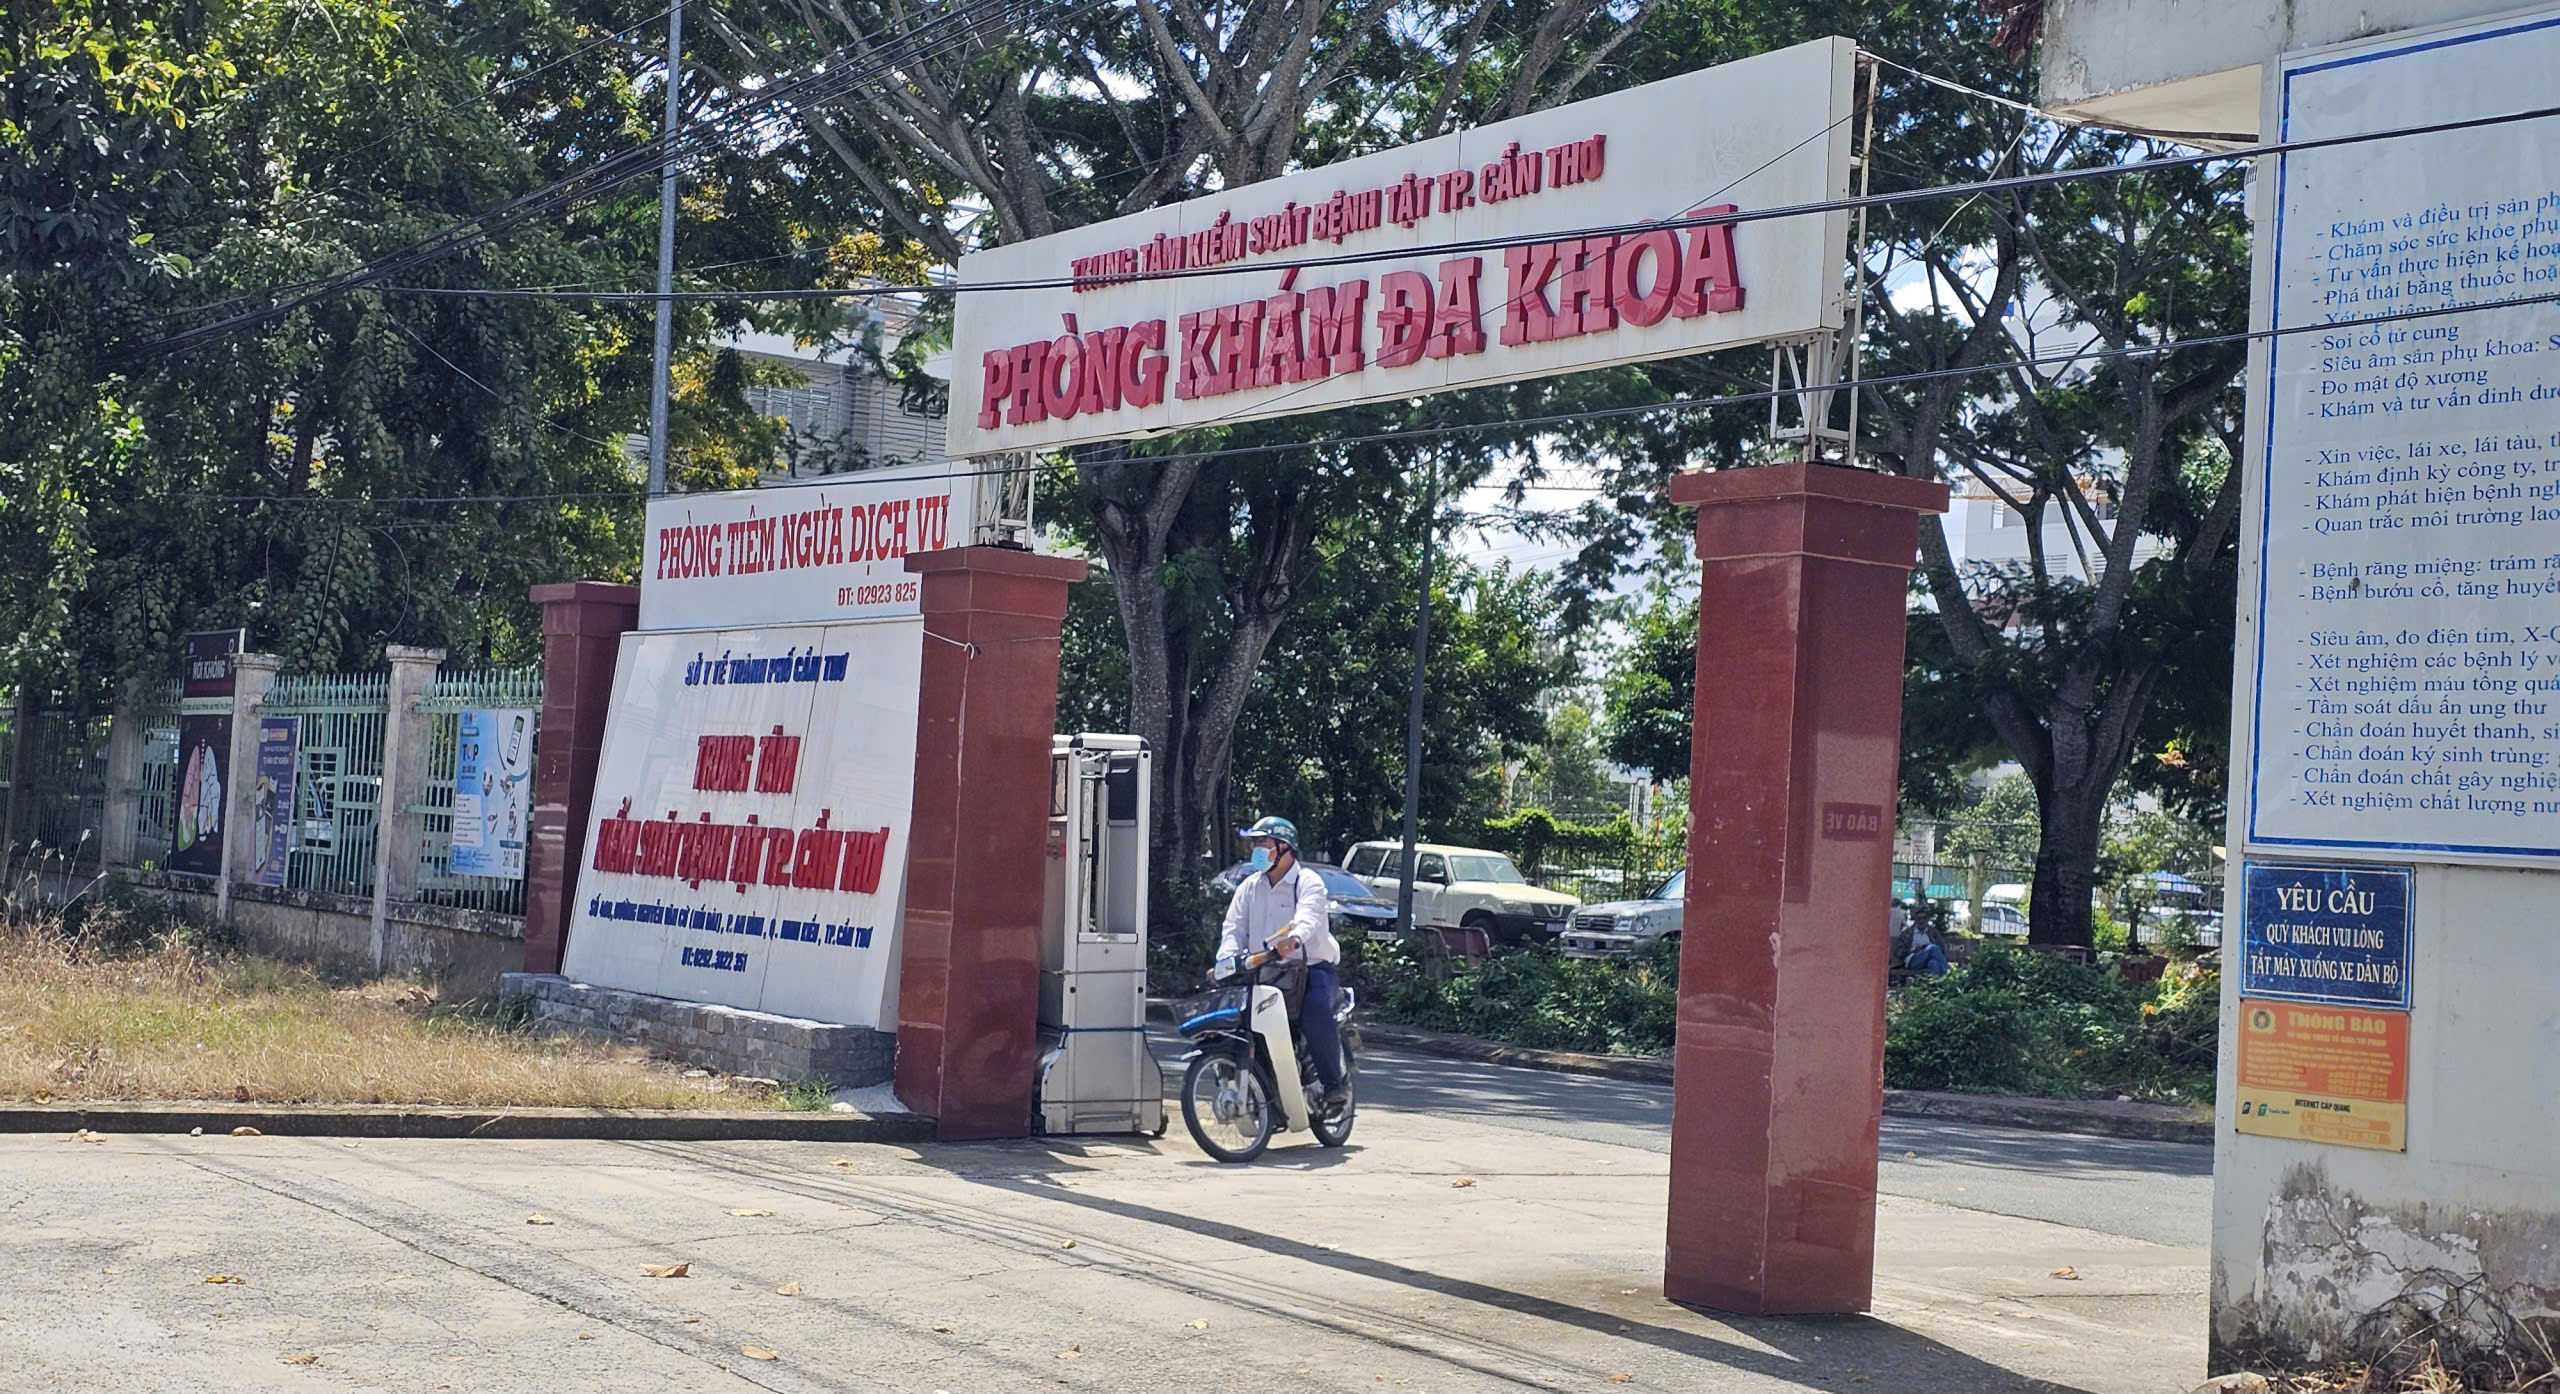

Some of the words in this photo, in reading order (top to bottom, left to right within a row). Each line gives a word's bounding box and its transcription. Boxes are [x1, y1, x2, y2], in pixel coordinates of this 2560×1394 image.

[1071, 248, 1138, 293] TRUNG
[1140, 233, 1187, 274] TÂM
[1188, 209, 1248, 268] KIỂM
[1249, 201, 1311, 255] SOÁT
[1312, 190, 1381, 245] BỆNH
[1385, 173, 1435, 229] TẬT
[1436, 169, 1475, 213] TP.
[1479, 141, 1542, 204] CẦN
[1545, 133, 1607, 189] THƠ
[2331, 220, 2384, 238] Khám
[2392, 213, 2413, 229] và
[2419, 203, 2460, 225] điều
[2468, 201, 2489, 221] trị
[2497, 198, 2529, 215] sản
[2328, 241, 2382, 260] Chăm
[2389, 234, 2419, 253] sóc
[2426, 230, 2459, 248] sức
[2466, 223, 2515, 243] khỏe
[2522, 218, 2559, 239] phụ
[2327, 267, 2353, 283] Tư
[2360, 257, 2391, 278] vấn
[2398, 257, 2439, 275] thực
[2446, 249, 2488, 268] hiện
[2496, 240, 2520, 261] kế
[2324, 287, 2359, 305] Phá
[2366, 281, 2400, 300] thải
[2407, 273, 2453, 296] bằng
[2460, 265, 2516, 289] thuốc
[977, 313, 1169, 430] PHÒNG
[1174, 266, 1369, 401] KHÁM
[1376, 256, 1487, 369] ĐA
[1500, 203, 1746, 347] KHOA
[2321, 379, 2347, 395] Đo
[2354, 375, 2389, 393] mật
[2395, 372, 2418, 389] độ
[2425, 369, 2488, 385] xương
[2318, 450, 2351, 465] Xin
[2358, 445, 2401, 463] việc,
[2408, 442, 2432, 458] lái
[2438, 443, 2467, 458] xe,
[2475, 436, 2498, 453] lái
[2506, 434, 2542, 451] tàu,
[2317, 470, 2370, 488] Khám
[2376, 465, 2419, 485] định
[2427, 463, 2451, 484] kỳ
[2457, 461, 2507, 478] công
[2514, 461, 2536, 478] ty,
[2315, 516, 2362, 535] Quan
[2369, 509, 2404, 530] trắc
[2411, 511, 2449, 528] môi
[2456, 507, 2529, 527] trường
[2531, 505, 2560, 521] lao
[657, 510, 722, 580] PHÒNG
[727, 504, 777, 575] TIÊM
[780, 492, 843, 570] NGỪA
[849, 500, 910, 576] DỊCH
[2312, 561, 2359, 581] Bệnh
[2365, 560, 2408, 579] răng
[2415, 557, 2481, 577] miệng:
[2490, 555, 2536, 571] trám
[838, 587, 853, 606] ĐT:
[857, 584, 892, 605] 02923
[895, 582, 917, 602] 825
[2310, 630, 2349, 646] Siêu
[2356, 630, 2389, 647] âm,
[2396, 629, 2420, 645] đo
[2427, 628, 2468, 647] điện
[2476, 627, 2515, 645] tim,
[703, 661, 712, 685] Y
[712, 650, 731, 685] TẾ
[728, 653, 768, 684] THÀNH
[767, 646, 796, 683] PHỐ
[2309, 653, 2341, 669] Xét
[2347, 652, 2418, 672] nghiệm
[2424, 653, 2457, 667] các
[2464, 651, 2512, 670] bệnh
[2520, 650, 2539, 671] lý
[2308, 677, 2340, 692] Xét
[2346, 676, 2417, 695] nghiệm
[2423, 676, 2465, 692] máu
[2472, 671, 2517, 695] tổng
[2307, 695, 2348, 714] Tầm
[2354, 698, 2392, 714] soát
[2398, 695, 2433, 715] dấu
[2439, 695, 2462, 715] ấn
[2469, 701, 2507, 719] ung
[2513, 699, 2547, 715] thư
[2306, 718, 2354, 738] Chẩn
[2359, 721, 2405, 738] đoán
[2413, 718, 2467, 742] huyết
[2473, 722, 2535, 741] thanh,
[693, 735, 755, 793] TRUNG
[754, 724, 801, 794] TÂM
[2303, 791, 2335, 806] Xét
[2342, 792, 2413, 811] nghiệm
[2420, 789, 2460, 810] chất
[2468, 794, 2526, 816] lượng
[839, 827, 890, 895] THƠ
[2277, 881, 2322, 912] YÊU
[2328, 879, 2375, 915] CẦU
[2266, 919, 2289, 944] QUÝ
[2292, 920, 2330, 946] KHÁCH
[2333, 928, 2351, 947] VUI
[2353, 923, 2384, 950] LÒNG
[2251, 947, 2271, 975] TẮT
[2273, 952, 2298, 976] MÁY
[2299, 951, 2338, 980] XUỐNG
[2339, 961, 2354, 981] XE
[2356, 954, 2380, 983] DẪN
[2383, 961, 2399, 988] BỘ
[2288, 1011, 2345, 1031] THÔNG
[2295, 1099, 2320, 1109] INTERNET
